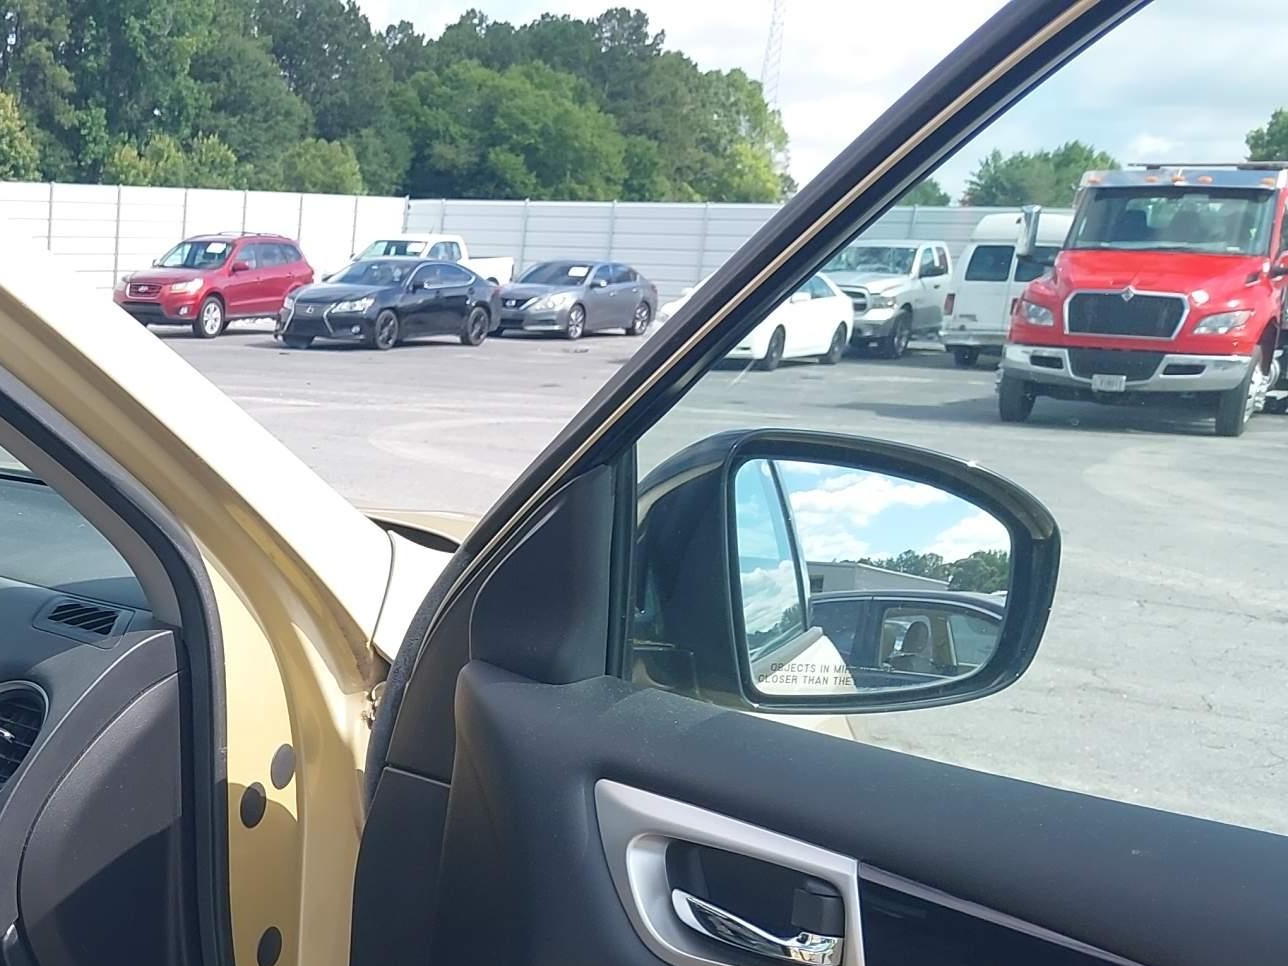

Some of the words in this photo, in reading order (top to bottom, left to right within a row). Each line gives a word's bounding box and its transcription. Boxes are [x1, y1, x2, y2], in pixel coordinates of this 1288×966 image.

[770, 663, 816, 673] OBJECTS
[820, 664, 829, 673] IN
[758, 674, 798, 684] CLOSER
[802, 675, 829, 685] THAN
